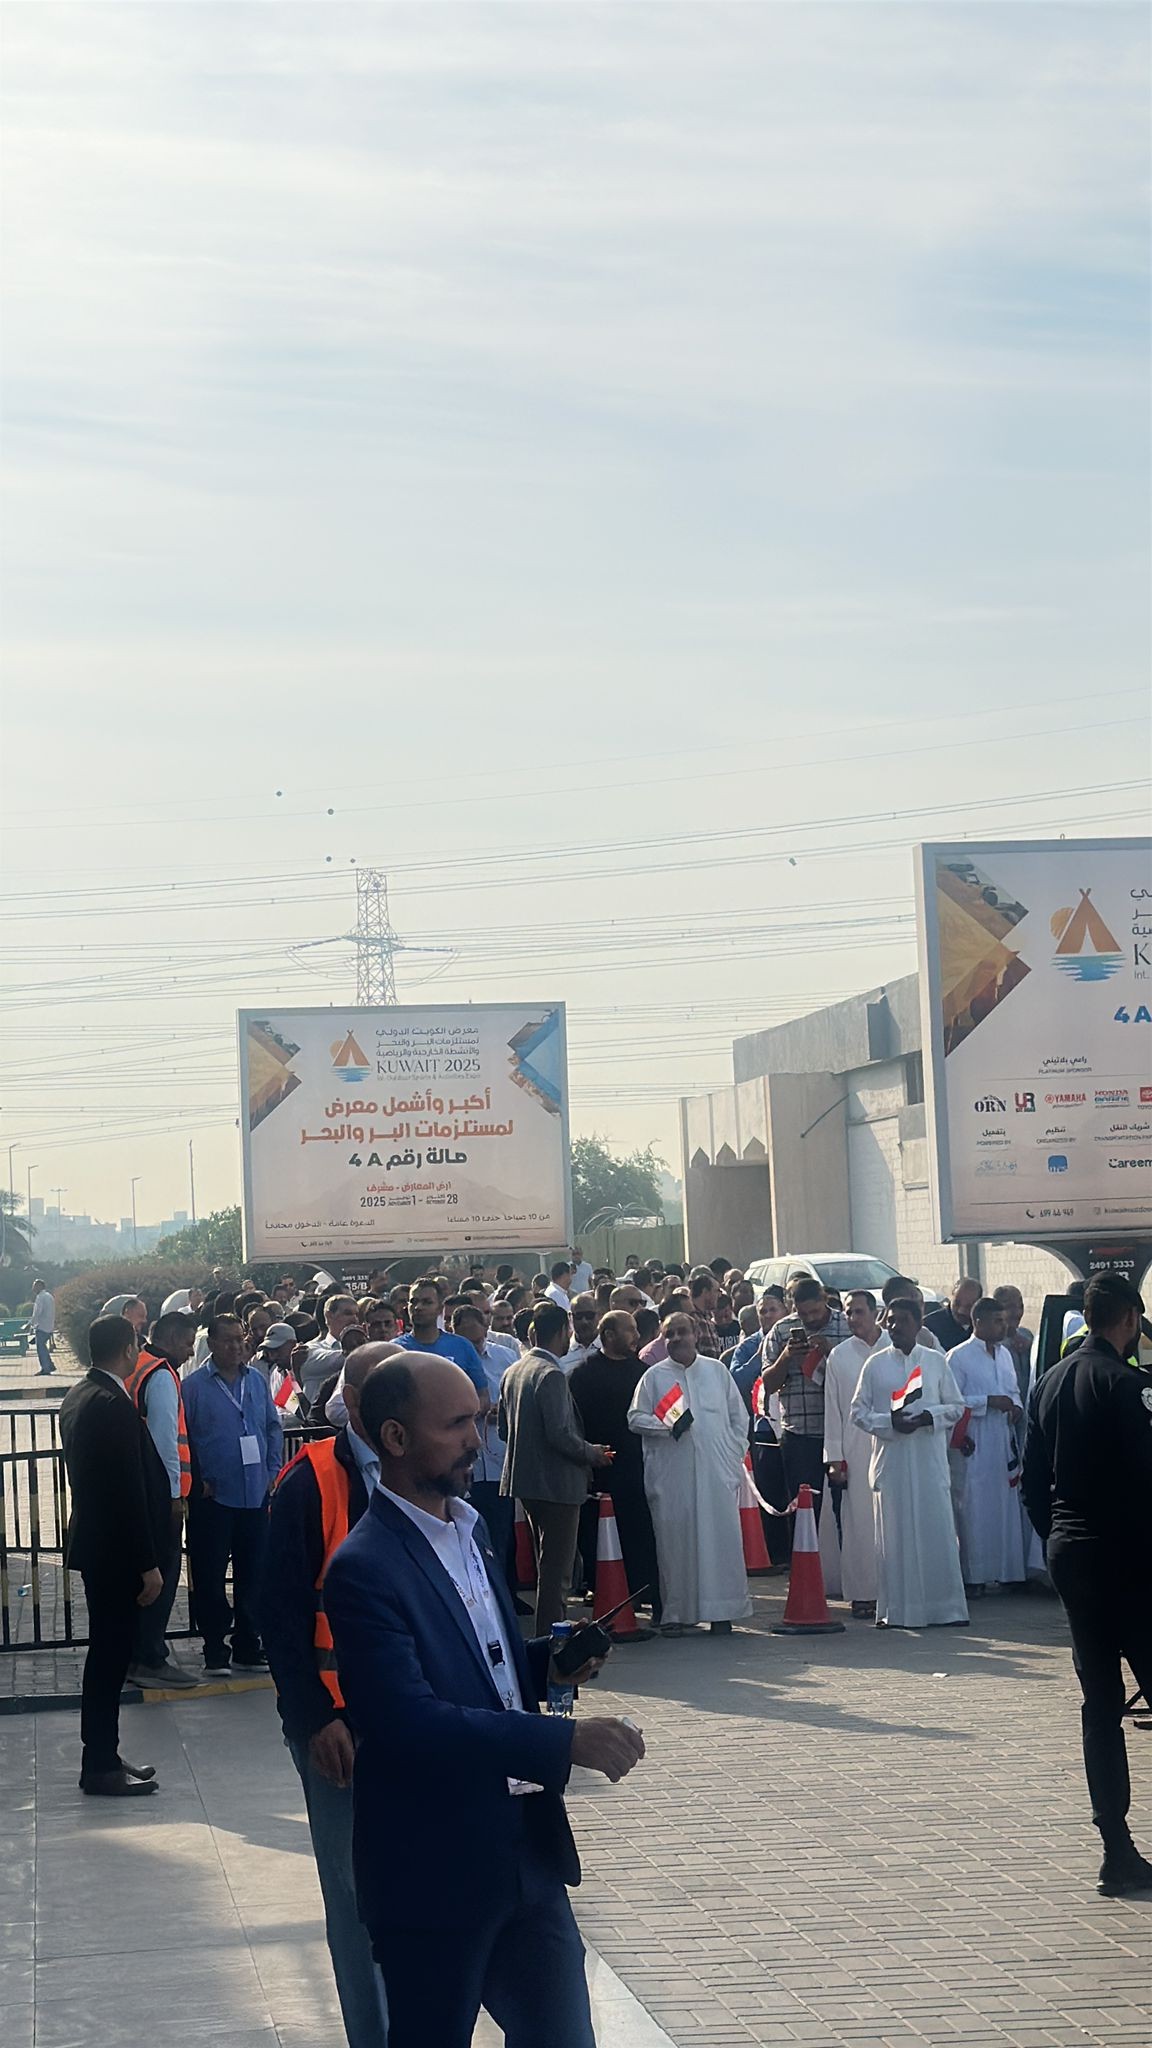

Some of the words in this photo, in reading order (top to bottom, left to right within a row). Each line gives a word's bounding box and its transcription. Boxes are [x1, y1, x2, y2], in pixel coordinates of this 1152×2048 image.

[1113, 1005, 1131, 1024] 4
[1134, 1005, 1152, 1024] A
[375, 1027, 410, 1037] الدولي
[412, 1026, 446, 1036] الكويت
[449, 1027, 479, 1036] معرض
[377, 1060, 440, 1074] KUWAIT
[444, 1058, 480, 1072] 2025
[1042, 1056, 1068, 1067] بلاتيني
[1070, 1056, 1088, 1066] راعي
[382, 1088, 444, 1117] وأشمل
[448, 1087, 491, 1114] أكبر
[1054, 1093, 1087, 1104] YAMAHA
[325, 1098, 378, 1118] معرض
[974, 1099, 1007, 1113] ORN
[414, 1119, 514, 1141] لمستلزمات
[1045, 1126, 1066, 1135] تنظيم
[1129, 1121, 1150, 1131] شريك
[300, 1124, 364, 1144] والبحر
[369, 1122, 411, 1144] البر
[349, 1153, 362, 1167] 4
[367, 1152, 383, 1167] A
[386, 1148, 422, 1171] رقم
[425, 1147, 468, 1165] صالة
[366, 1181, 394, 1193] مشرف
[401, 1182, 434, 1193] المعارض
[360, 1196, 386, 1208] 2025
[446, 1193, 459, 1205] 28
[1089, 1261, 1110, 1270] 2491
[1113, 1260, 1135, 1268] 3333
